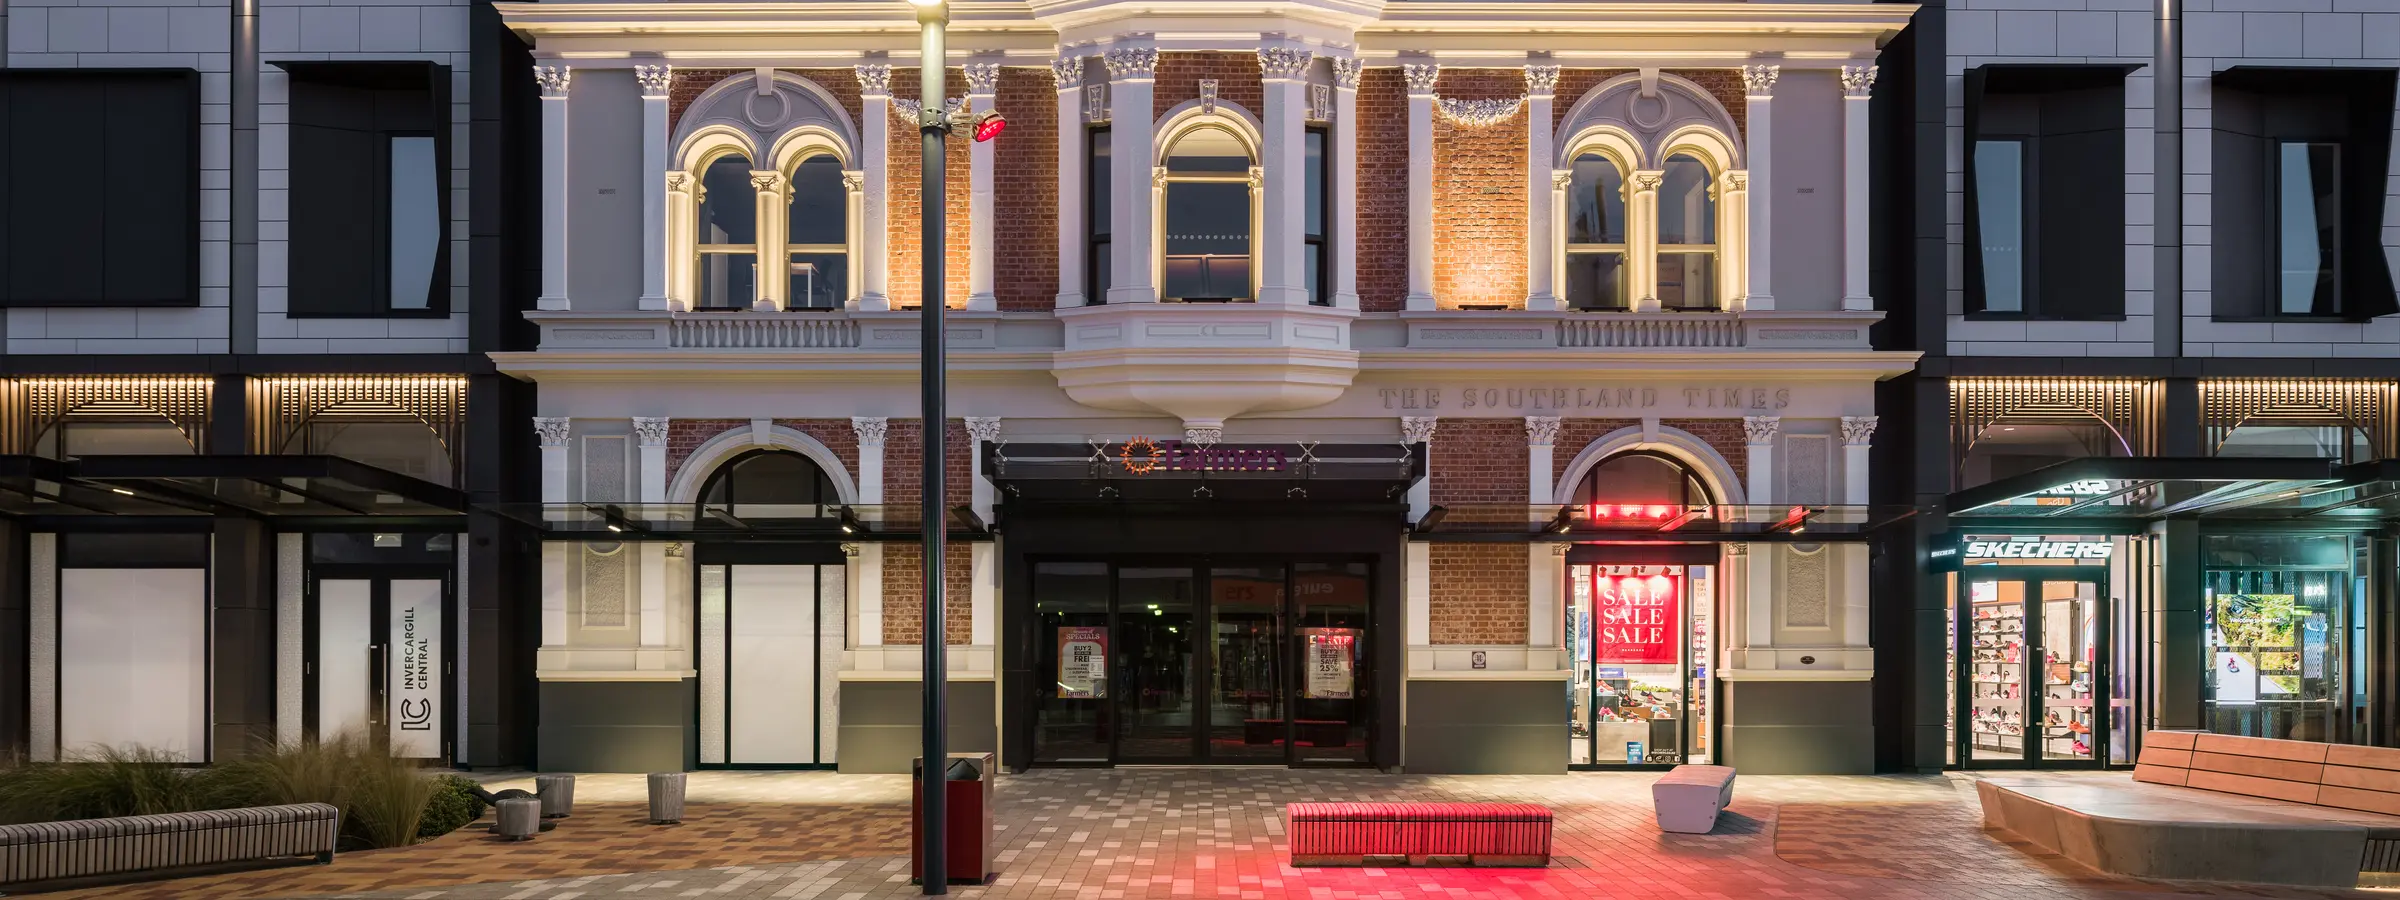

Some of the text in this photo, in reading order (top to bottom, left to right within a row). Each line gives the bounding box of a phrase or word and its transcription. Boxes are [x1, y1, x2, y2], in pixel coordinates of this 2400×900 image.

[1379, 388, 1791, 409] THE SOUTHLAND TIMES
[1160, 440, 1288, 471] Farmers
[1964, 541, 2115, 558] SKECHERS
[1603, 588, 1664, 606] SALE
[1603, 607, 1664, 625] SALE
[1603, 627, 1664, 644] SALE
[404, 606, 415, 690] INVERCARGILL
[418, 638, 428, 690] CENTRAL
[1320, 664, 1339, 672] 25%
